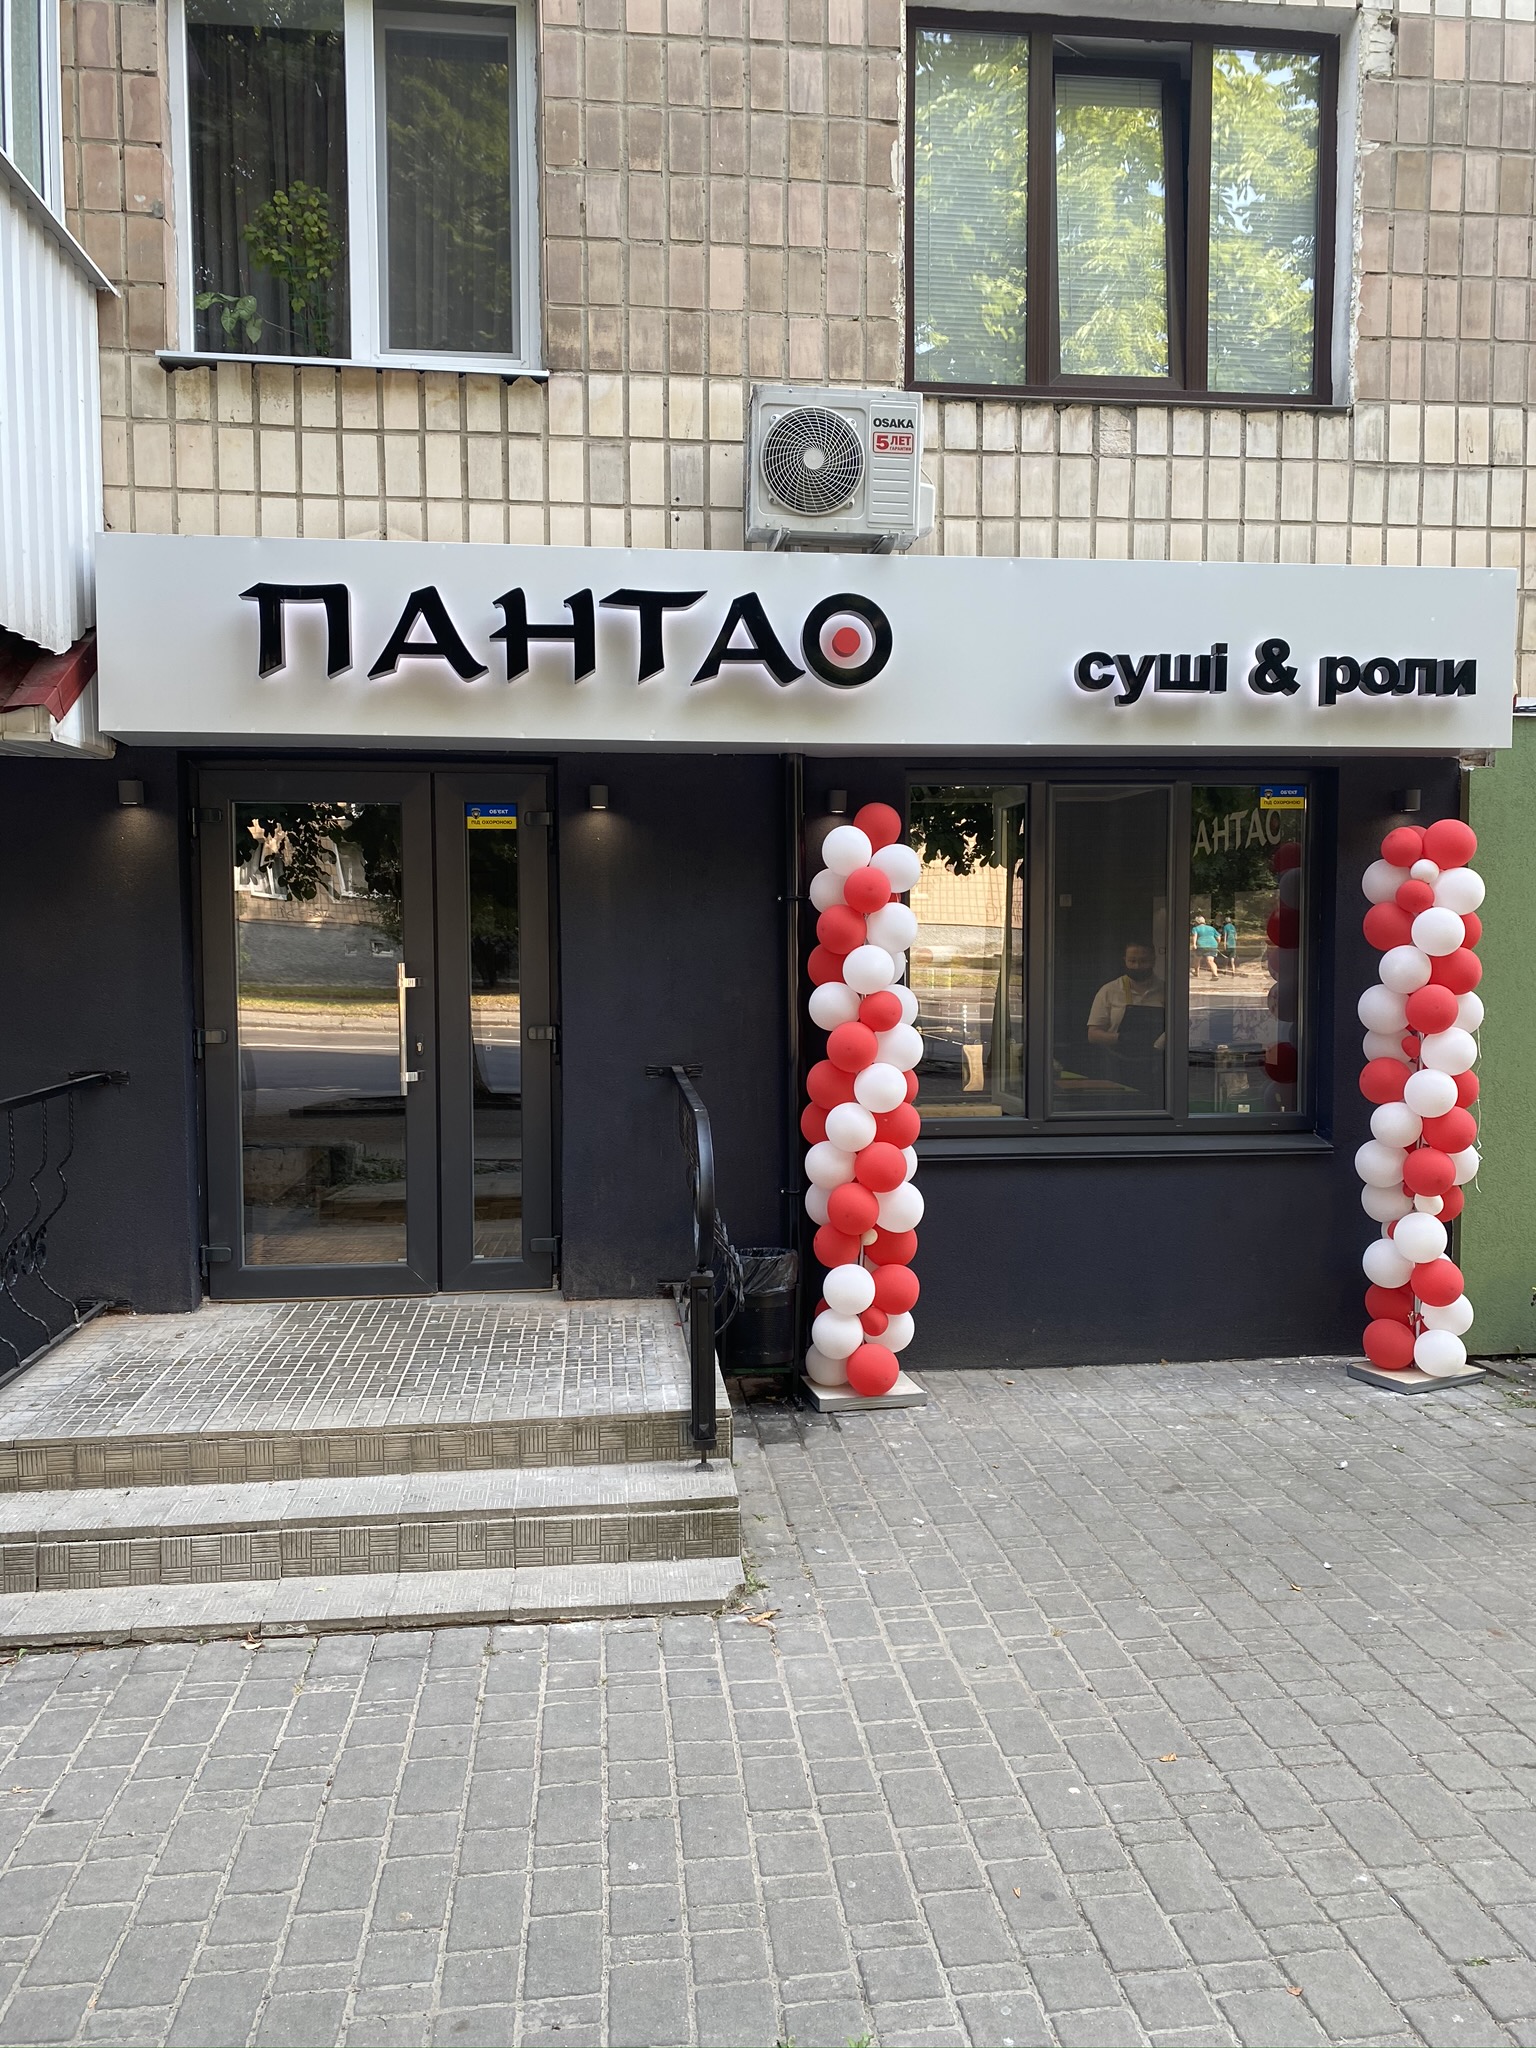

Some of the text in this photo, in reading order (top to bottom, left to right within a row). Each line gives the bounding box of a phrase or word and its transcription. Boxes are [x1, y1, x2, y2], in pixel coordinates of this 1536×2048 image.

[873, 418, 914, 429] OSAKA
[876, 435, 911, 450] 5 ЛЕТ
[238, 582, 893, 689] ПАНТАО
[1073, 637, 1477, 708] суші & роли
